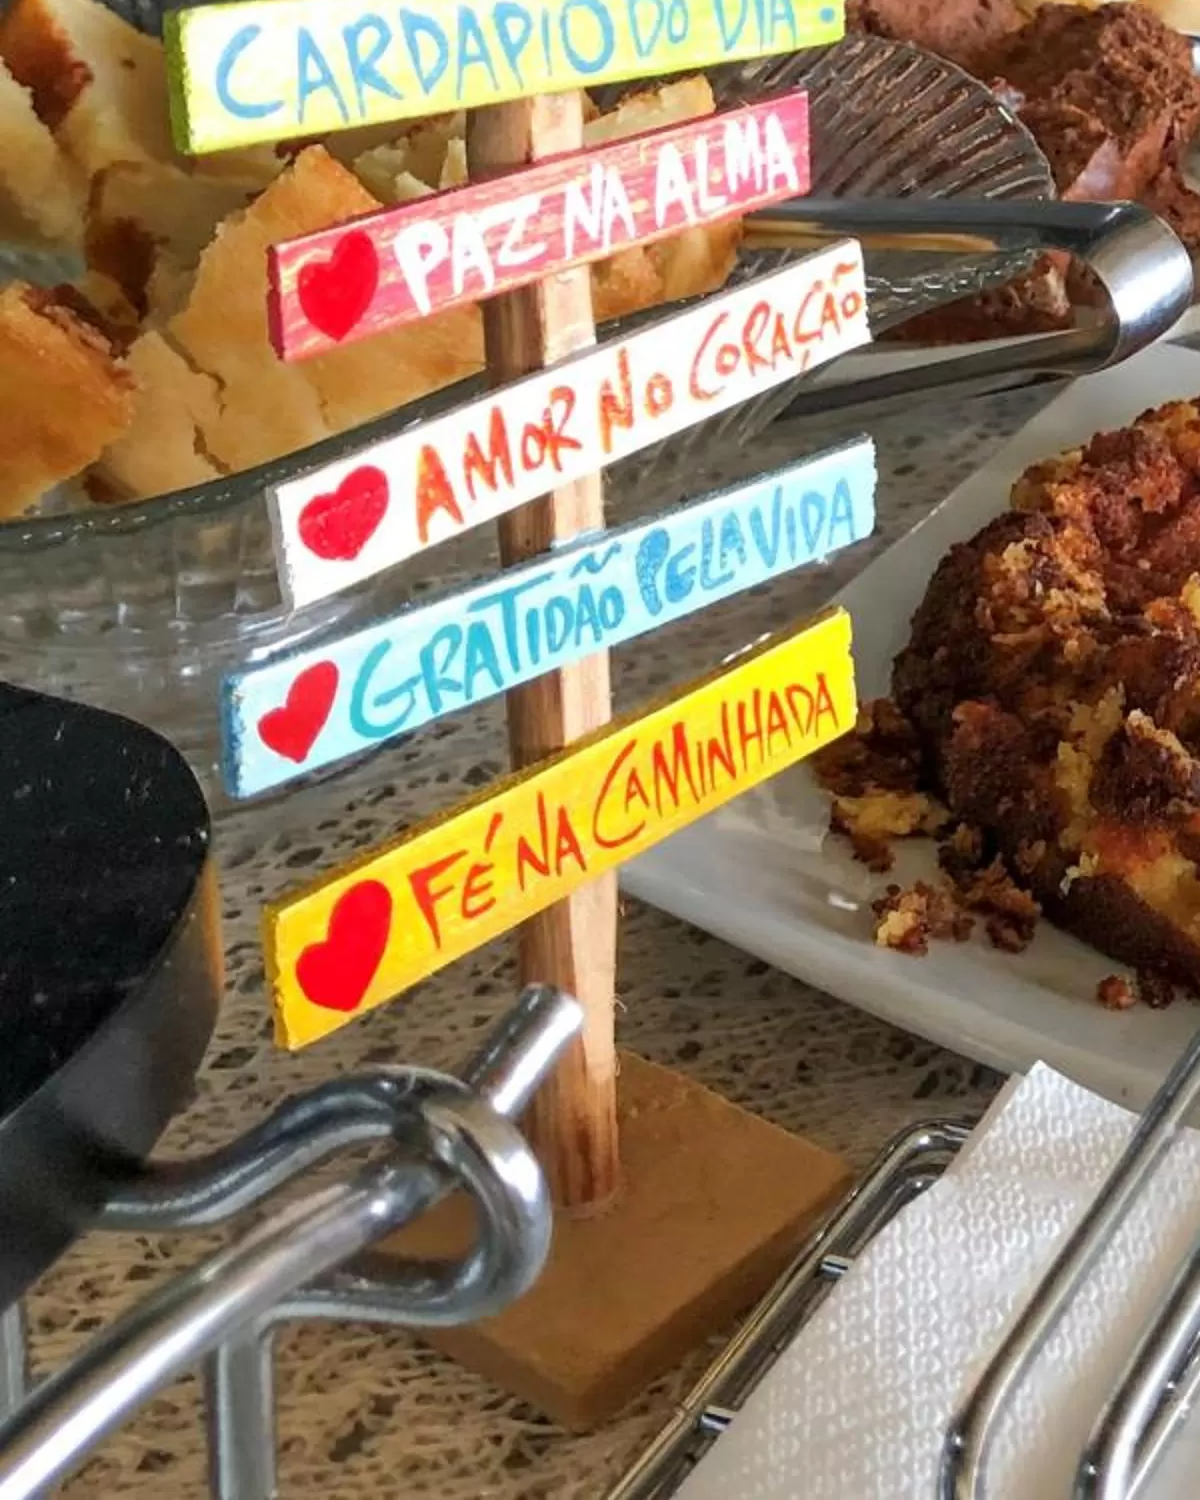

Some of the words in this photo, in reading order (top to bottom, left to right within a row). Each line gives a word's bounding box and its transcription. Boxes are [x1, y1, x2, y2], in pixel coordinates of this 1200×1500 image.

[393, 219, 545, 315] PAZ
[563, 164, 637, 260] NA
[655, 111, 800, 226] ALMA
[413, 385, 583, 544] AMOR
[688, 261, 862, 401] CORAÇÃO
[349, 543, 625, 740] GRATIDÃO
[748, 477, 856, 570] VIDA
[408, 811, 502, 950] FÉ
[515, 789, 588, 893] NA
[591, 672, 840, 849] CAMINHADA
